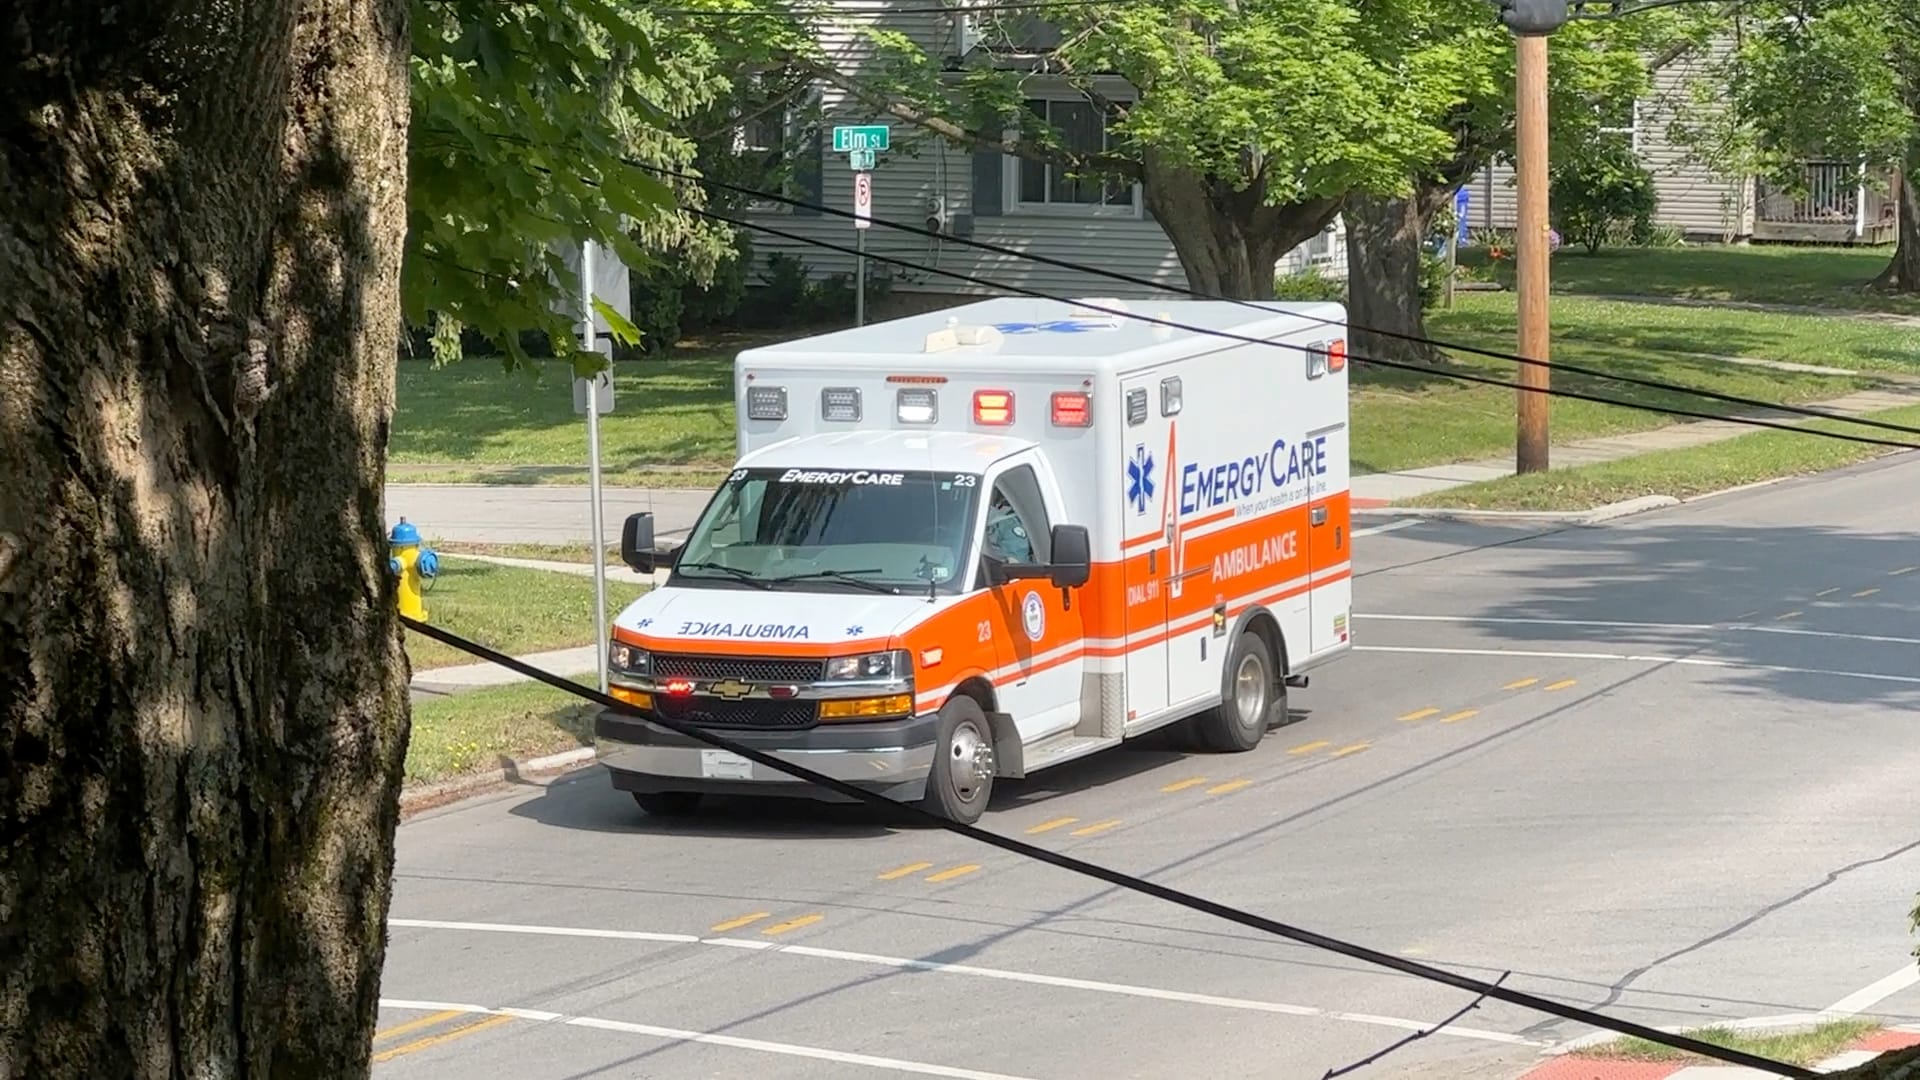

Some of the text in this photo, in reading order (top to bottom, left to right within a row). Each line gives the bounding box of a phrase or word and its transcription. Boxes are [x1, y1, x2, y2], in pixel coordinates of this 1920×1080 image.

[841, 129, 867, 149] Elm
[954, 474, 976, 487] 23
[1212, 530, 1297, 584] AMBULANCE
[1128, 579, 1159, 606] DIAL 911
[977, 620, 992, 642] 23
